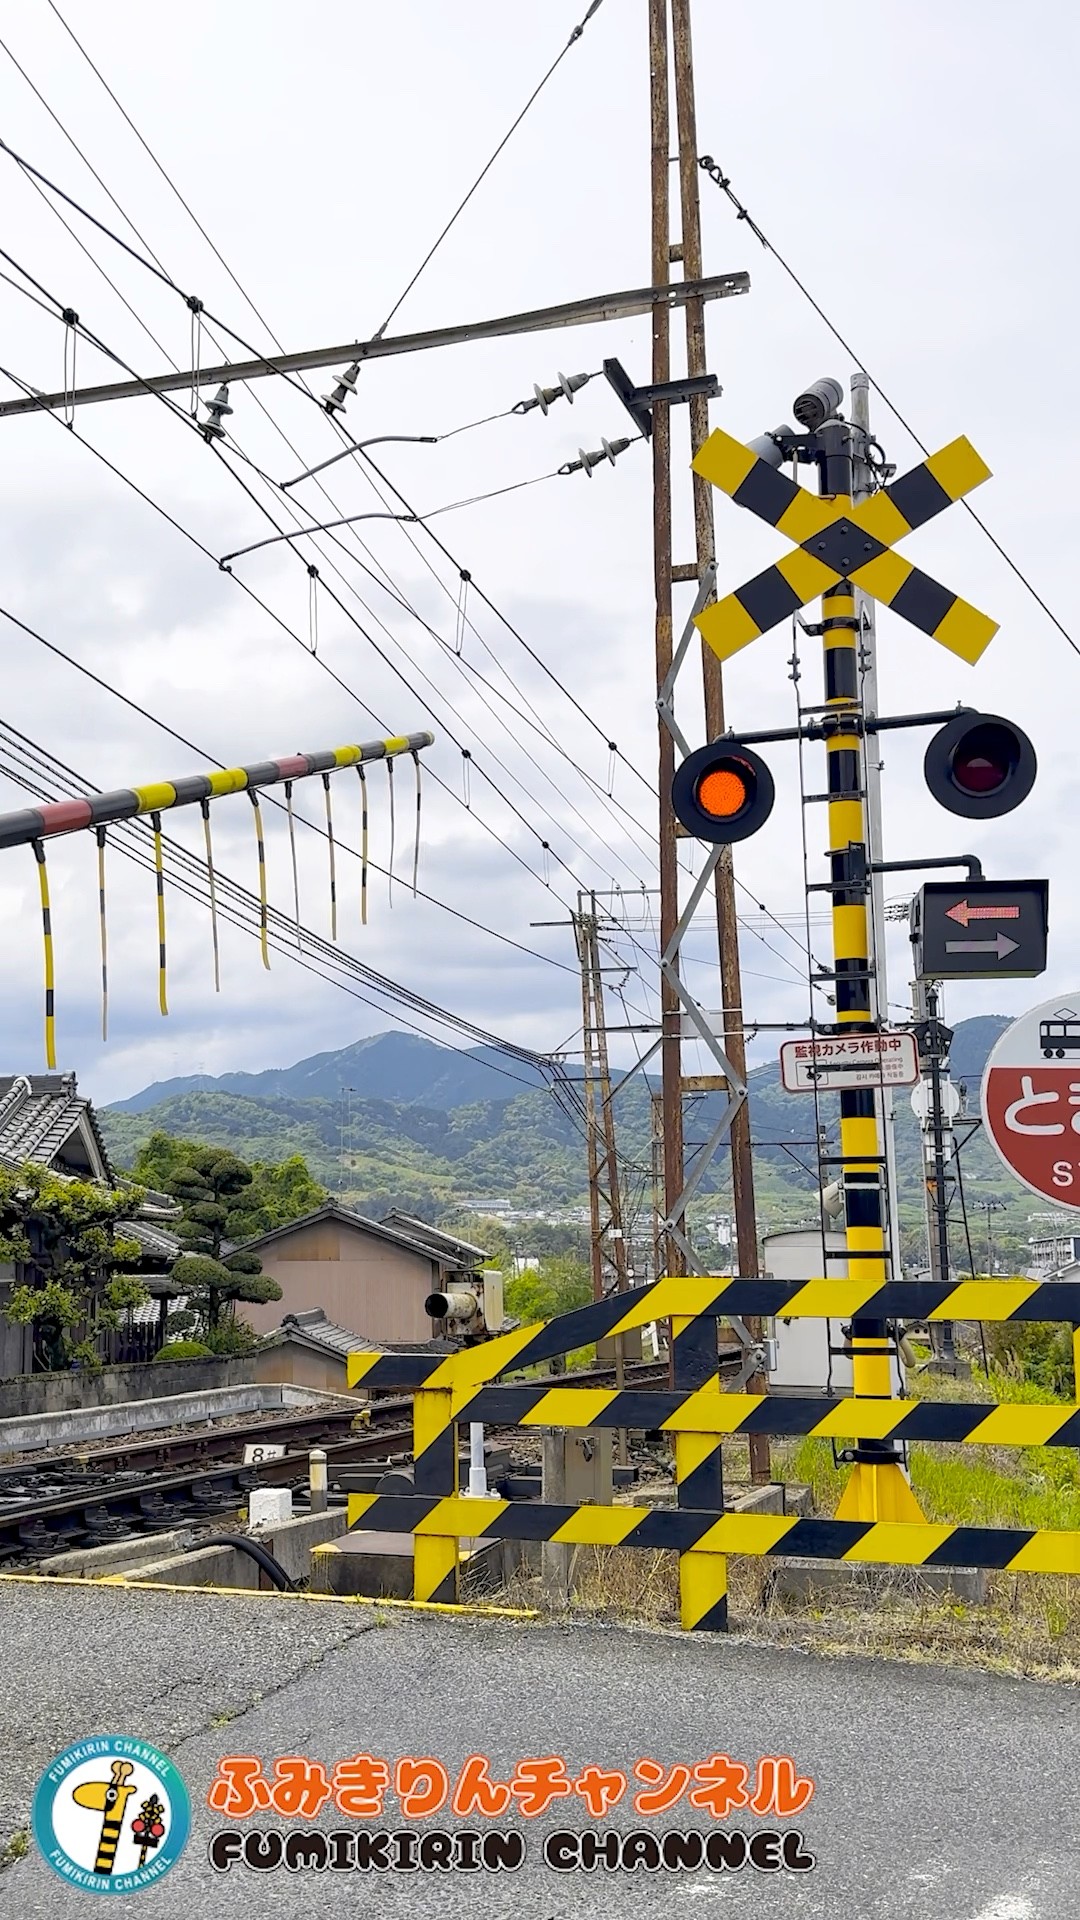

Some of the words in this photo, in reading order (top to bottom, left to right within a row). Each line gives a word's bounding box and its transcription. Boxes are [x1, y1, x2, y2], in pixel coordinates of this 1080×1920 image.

[795, 1038, 901, 1058] 監視カメラ作動中
